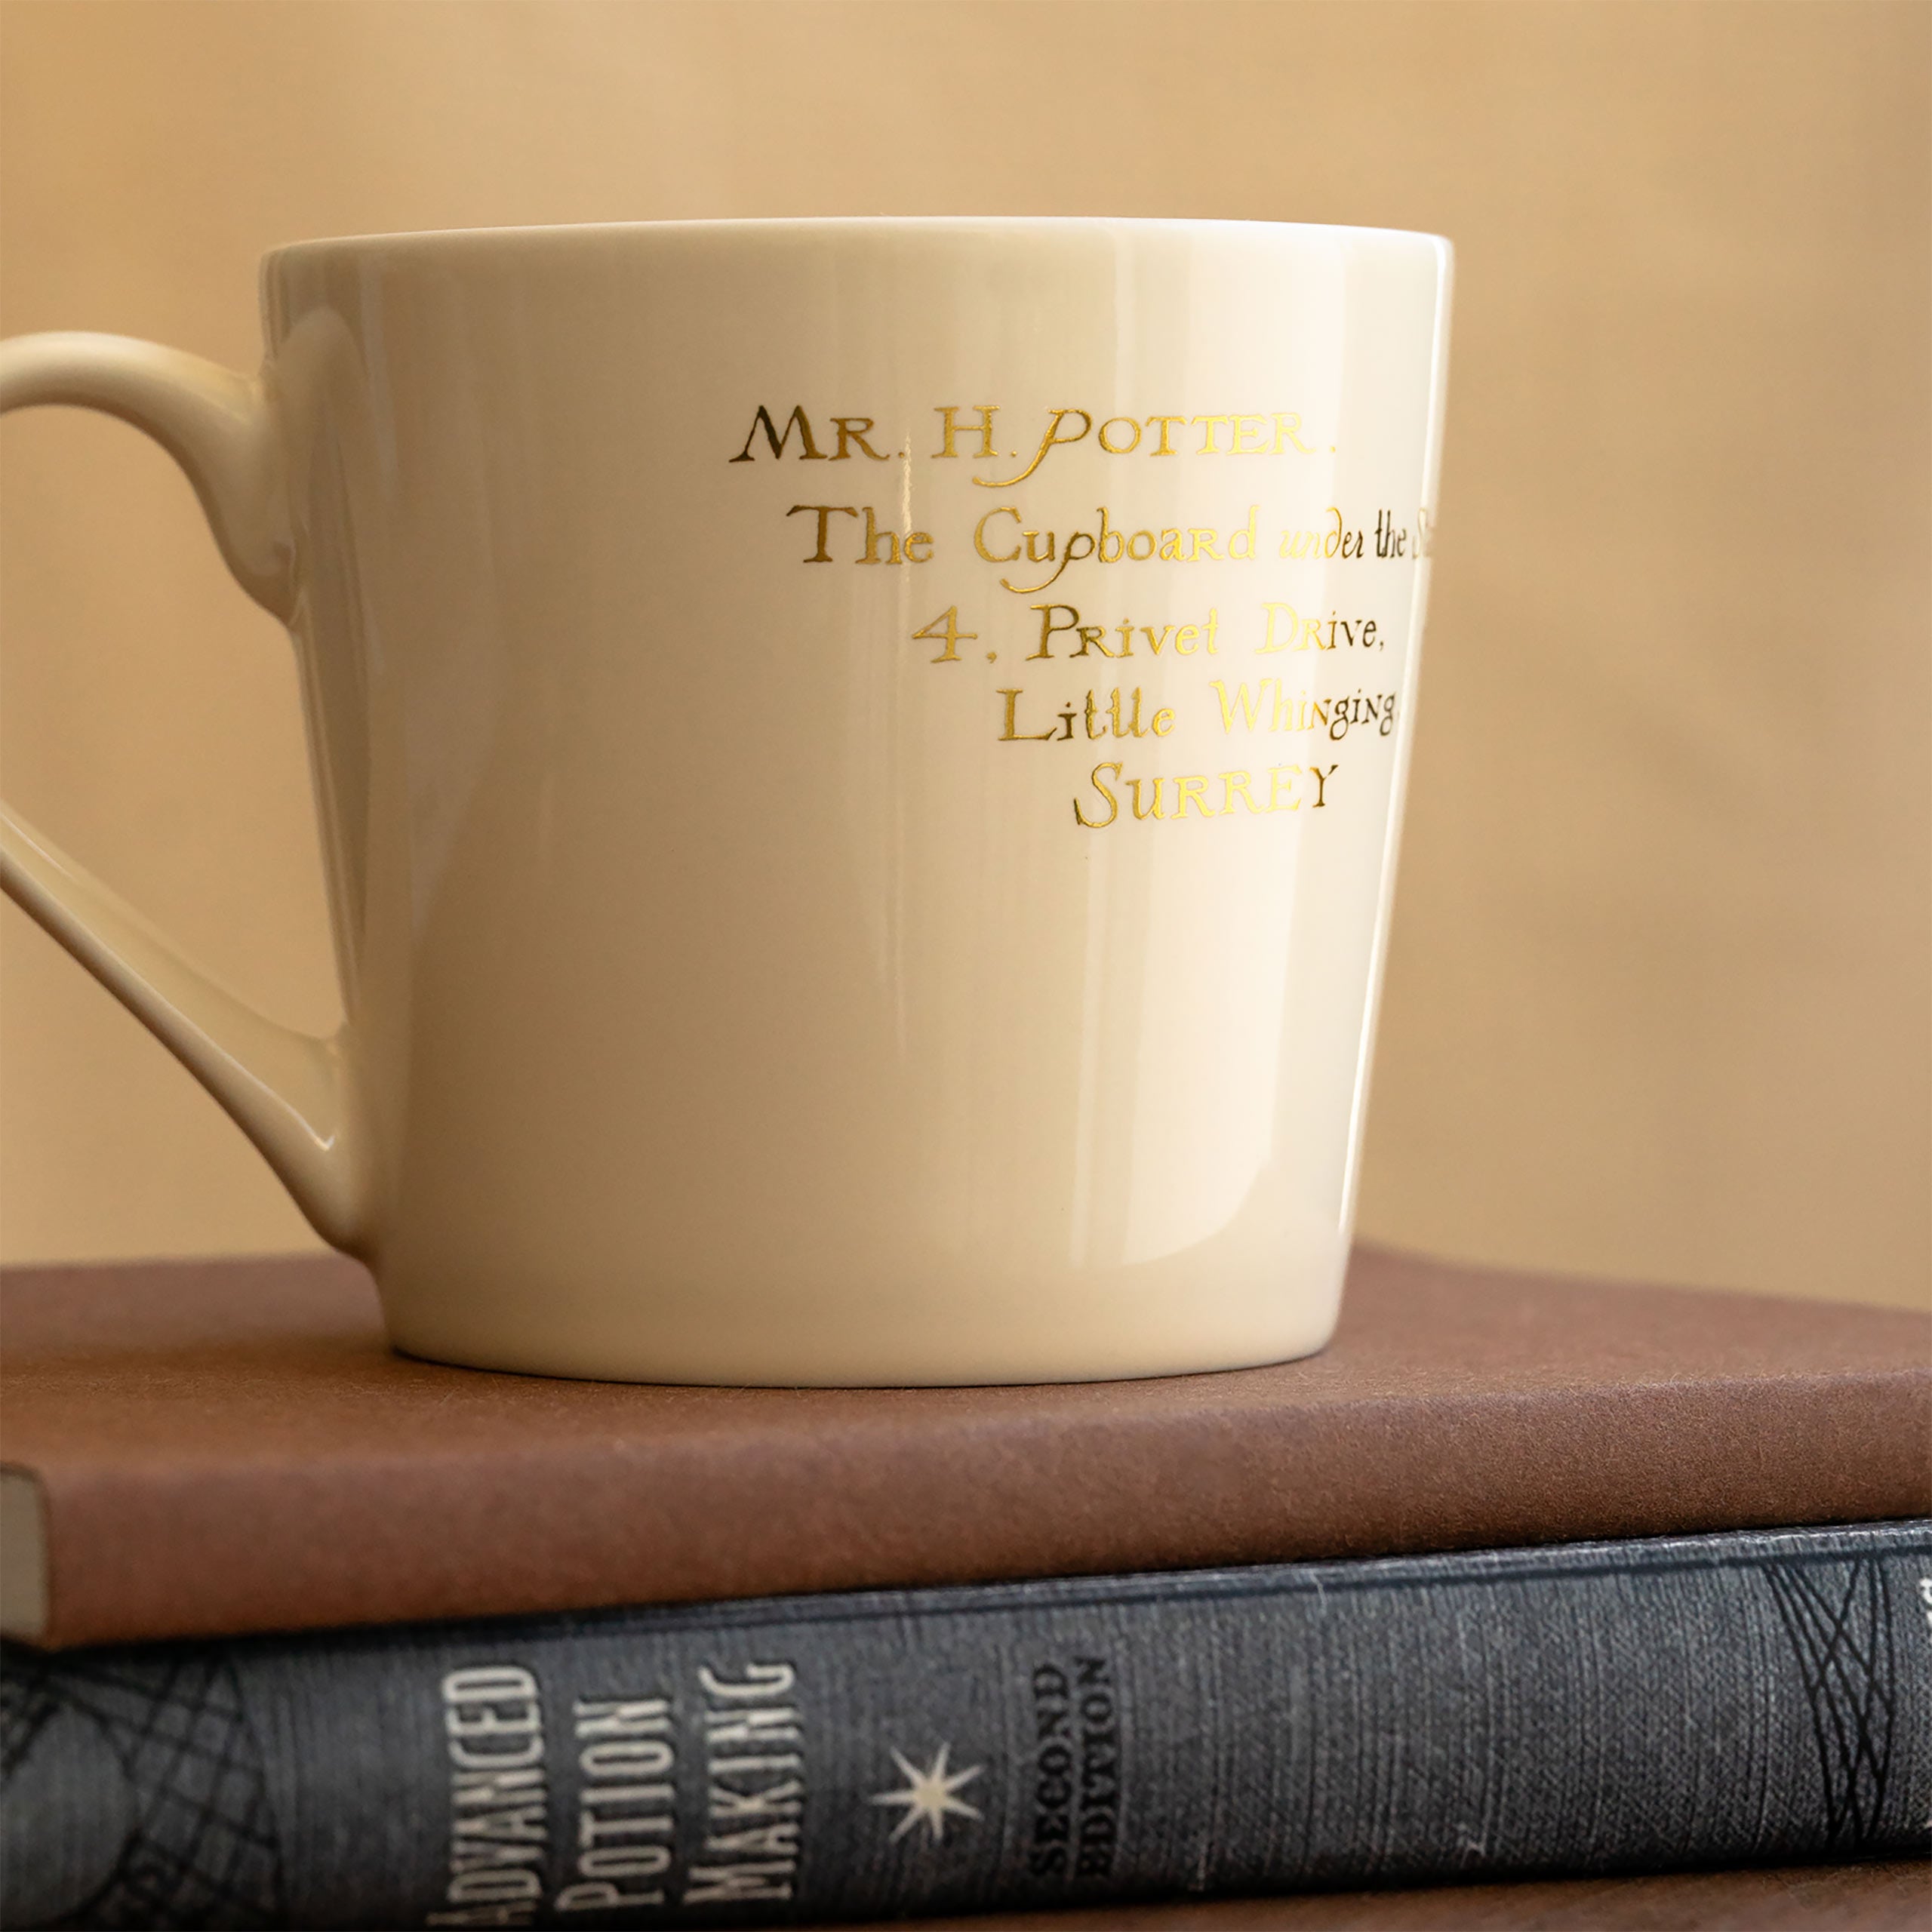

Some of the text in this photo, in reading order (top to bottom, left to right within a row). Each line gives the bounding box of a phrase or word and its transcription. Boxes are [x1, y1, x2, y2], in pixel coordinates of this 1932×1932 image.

[786, 505, 934, 565] The
[1280, 506, 1364, 559] under
[1374, 509, 1406, 558] the
[996, 687, 1176, 741] Little
[426, 1665, 548, 1927] ADVANCED
[554, 1698, 675, 1912] POTION
[682, 1662, 803, 1906] MAKING
[1027, 1663, 1073, 1876] SECOND
[1072, 1656, 1118, 1877] EDITION
